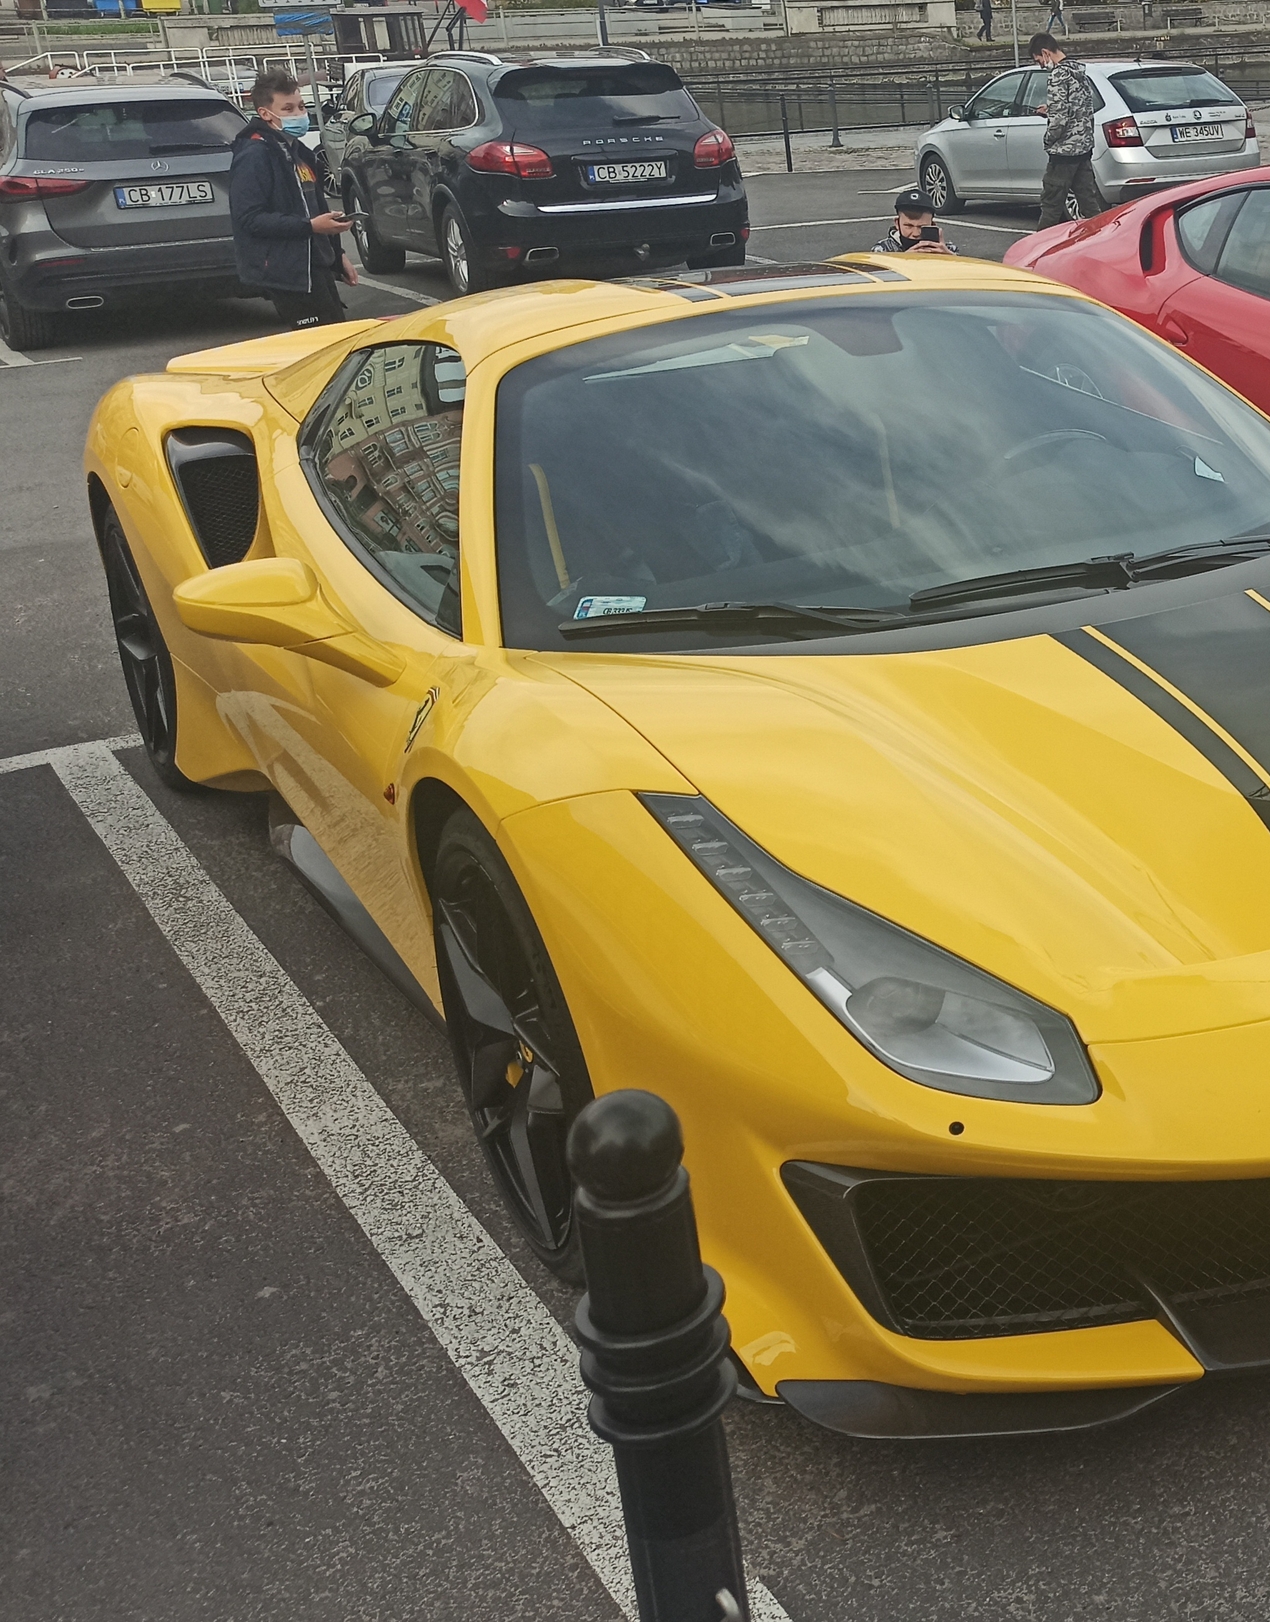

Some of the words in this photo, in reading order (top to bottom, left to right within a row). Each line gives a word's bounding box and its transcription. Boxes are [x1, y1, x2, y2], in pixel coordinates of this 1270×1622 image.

[1178, 127, 1191, 139] WE
[1194, 125, 1220, 137] 345UV
[582, 136, 664, 146] PORSCHE
[597, 165, 618, 180] CB
[621, 163, 664, 179] 5222Y
[128, 187, 151, 204] CB
[157, 184, 208, 202] 177LS
